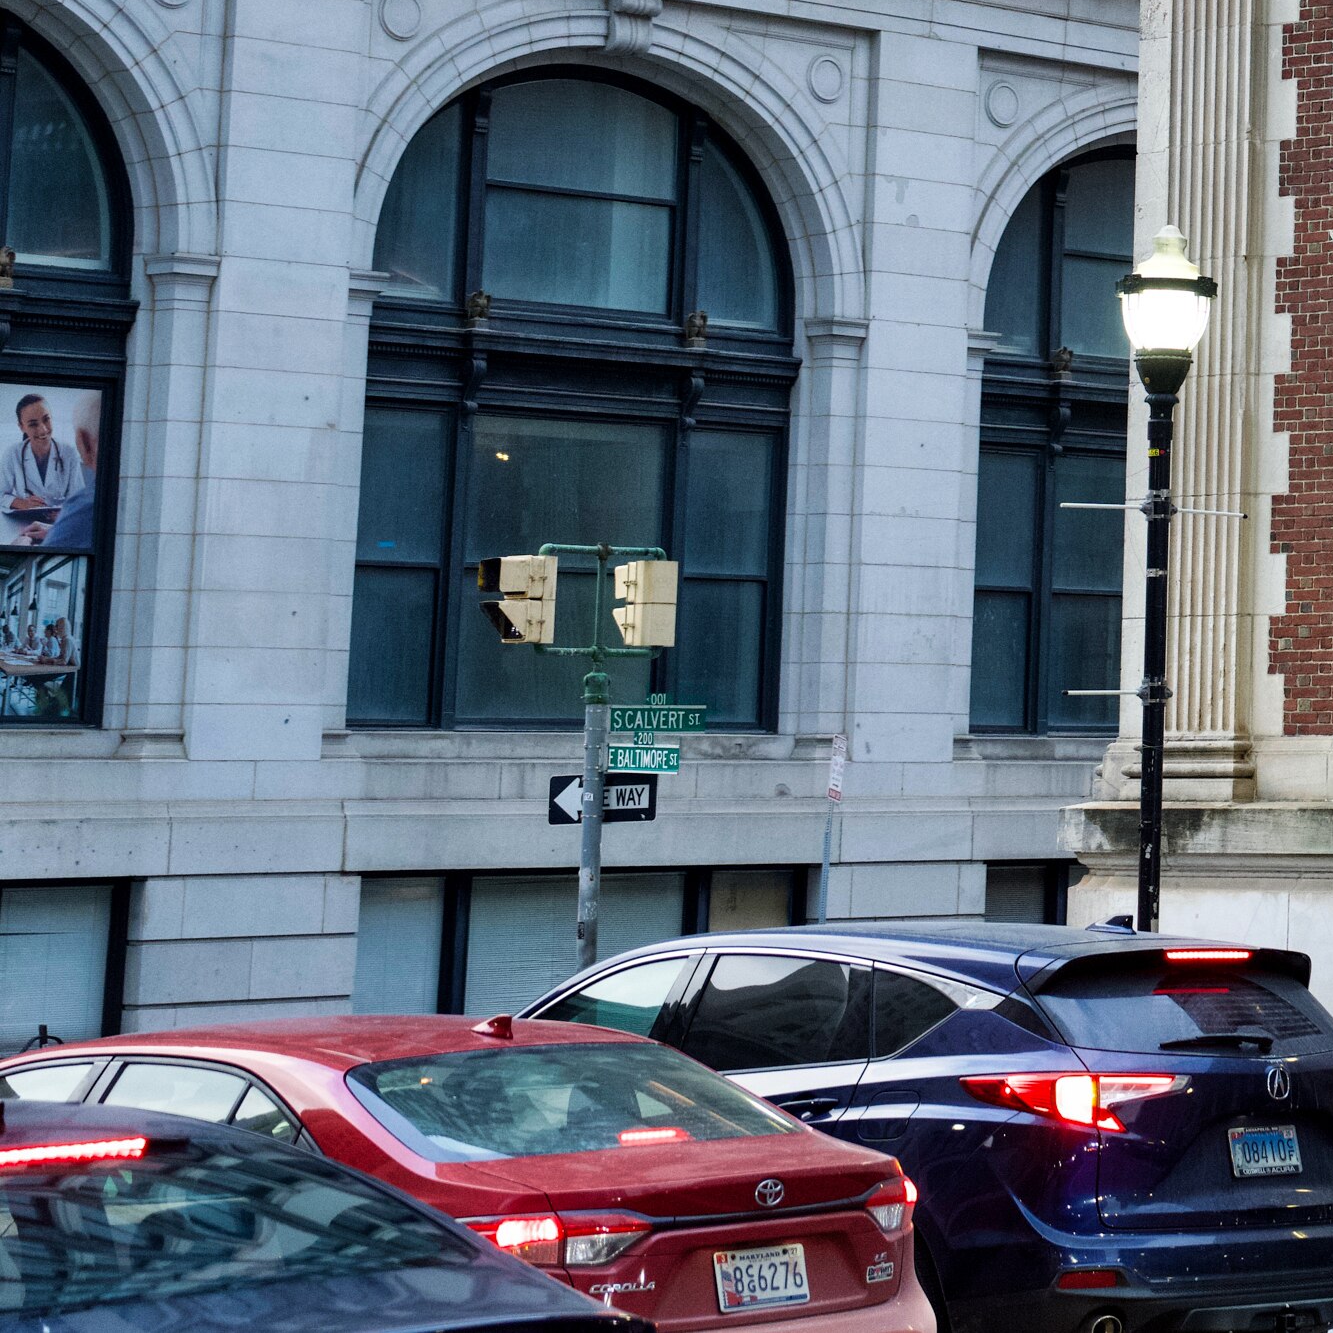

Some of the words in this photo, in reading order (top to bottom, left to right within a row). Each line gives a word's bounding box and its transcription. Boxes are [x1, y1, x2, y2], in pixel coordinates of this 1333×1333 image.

[613, 711, 622, 729] S
[625, 711, 686, 729] CALVERT
[638, 733, 653, 744] 200
[608, 749, 615, 767] E
[617, 749, 669, 768] BALTIMORE
[616, 787, 645, 807] WAY
[739, 1251, 780, 1261] MARYLAND
[588, 1281, 656, 1294] COROLLA
